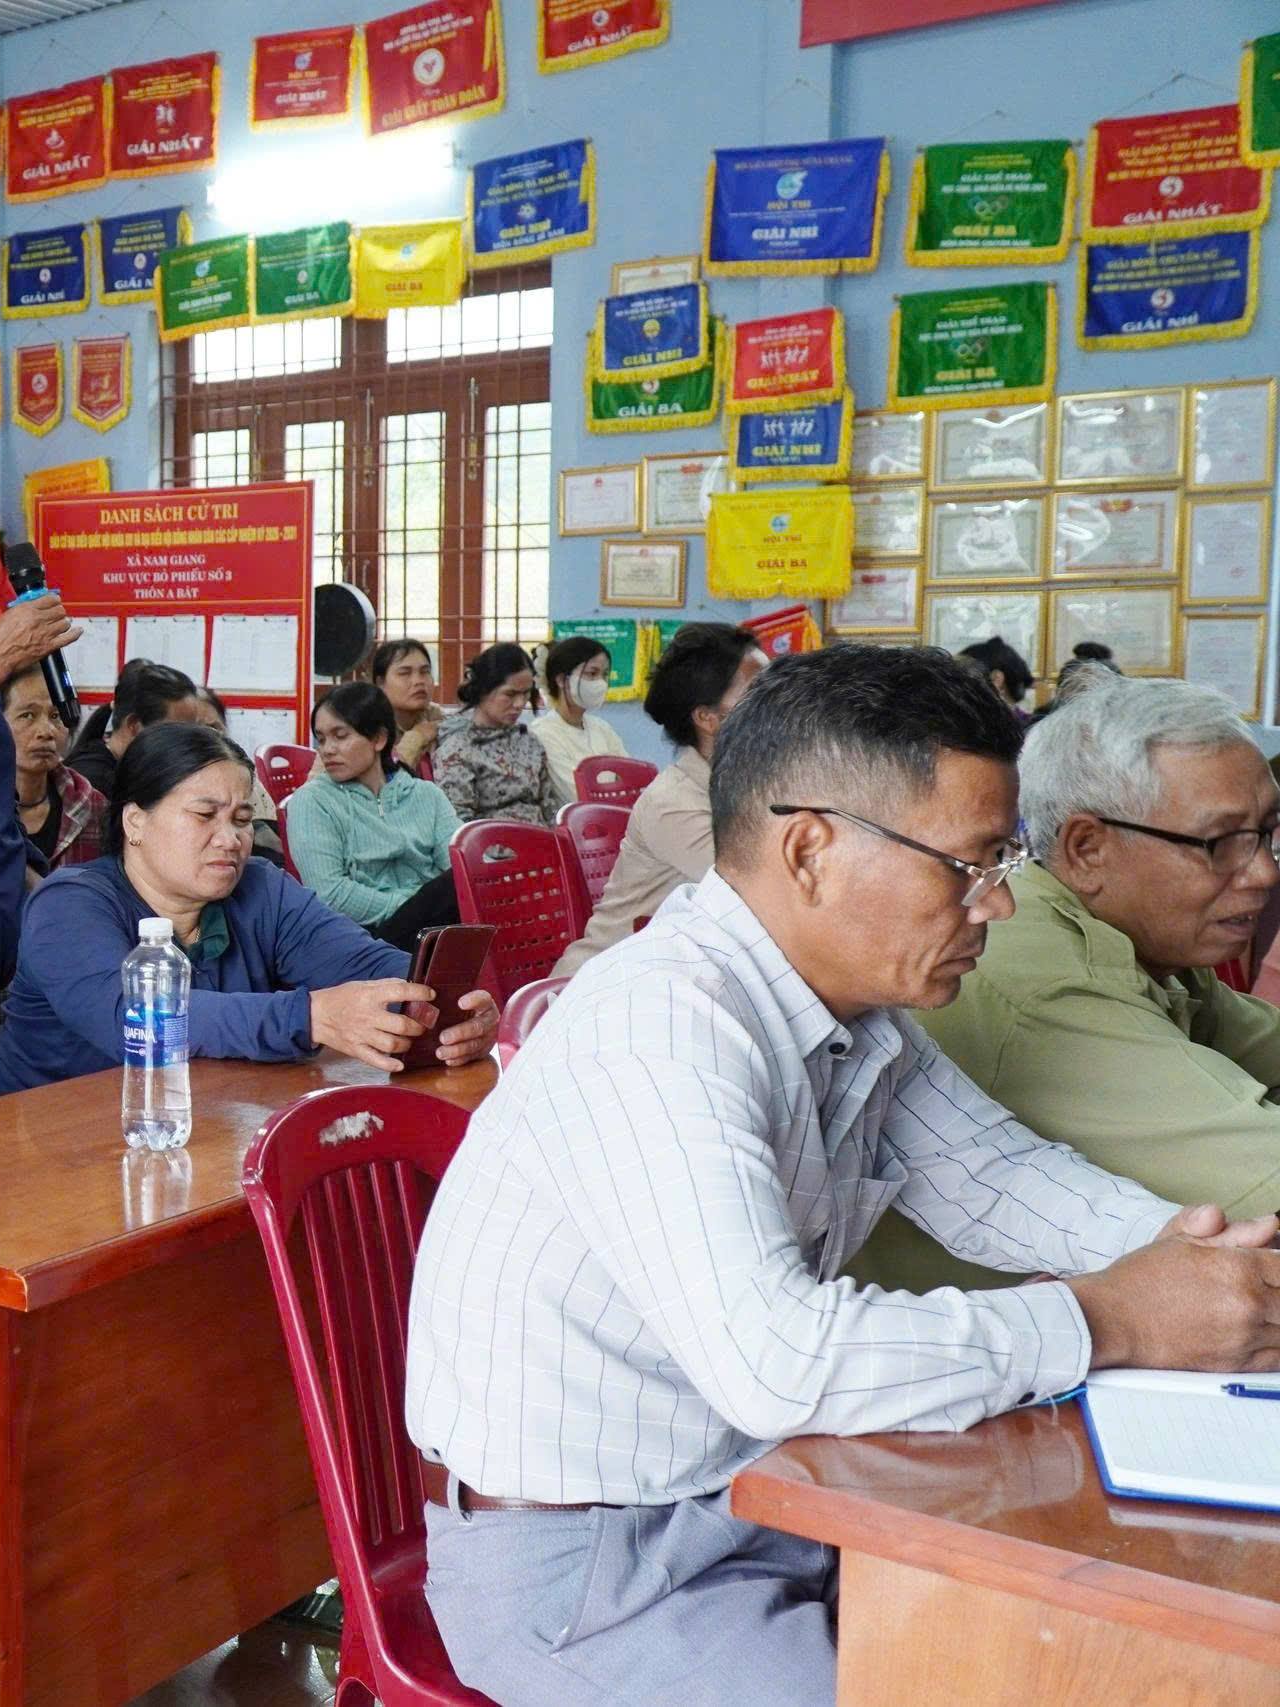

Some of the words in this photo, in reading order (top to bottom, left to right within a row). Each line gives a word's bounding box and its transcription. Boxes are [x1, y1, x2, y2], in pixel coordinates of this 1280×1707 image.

[1122, 317, 1161, 333] GIẢI
[1168, 312, 1198, 327] NHÌ
[618, 402, 653, 417] GIẢI
[658, 403, 683, 414] BA
[100, 508, 140, 524] DANH
[143, 503, 183, 523] SÁCH
[187, 499, 209, 520] CỬ
[212, 504, 238, 519] TRI
[127, 553, 141, 566] XÃ
[144, 556, 167, 566] NAM
[170, 554, 205, 565] GIANG
[103, 572, 126, 584] KHU
[128, 572, 151, 585] VỰC
[153, 568, 168, 582] BỎ
[171, 567, 205, 582] PHIẾU
[208, 567, 224, 581] SỐ
[225, 571, 232, 581] 3
[134, 586, 164, 599] THÔN
[166, 589, 174, 598] A
